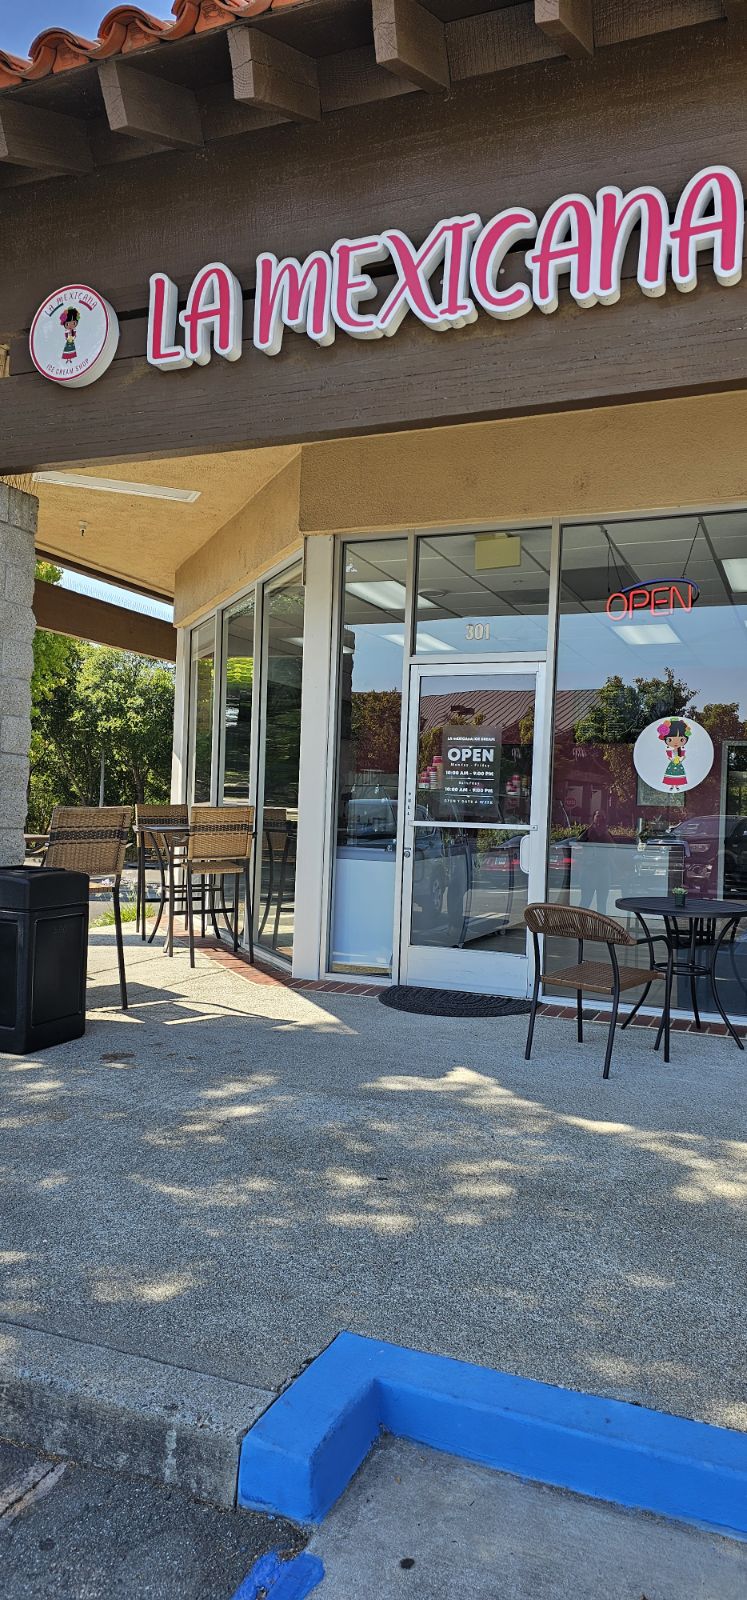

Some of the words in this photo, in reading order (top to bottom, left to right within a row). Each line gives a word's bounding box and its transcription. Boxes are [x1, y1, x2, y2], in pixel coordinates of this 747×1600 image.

[148, 263, 239, 366] LA
[254, 165, 745, 350] MEXICANA
[56, 291, 98, 309] MEXICANA
[46, 363, 56, 373] ICE
[56, 367, 74, 375] CREAM
[75, 358, 89, 371] SHOP
[606, 584, 693, 622] OPEN
[465, 623, 491, 641] 301
[447, 747, 494, 762] OPEN
